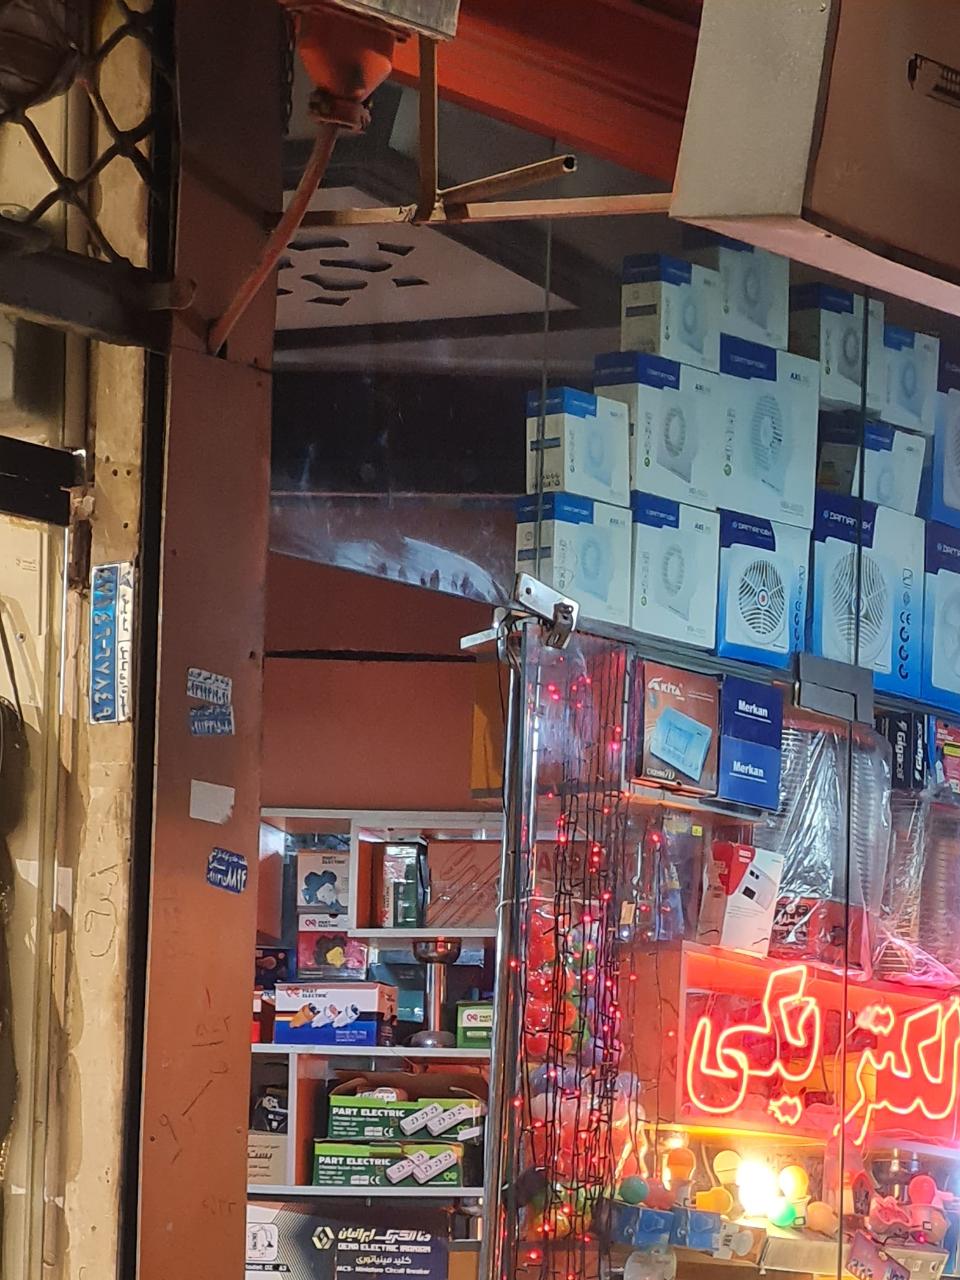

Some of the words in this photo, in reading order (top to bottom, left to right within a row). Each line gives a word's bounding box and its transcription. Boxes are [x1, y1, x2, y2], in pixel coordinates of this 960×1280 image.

[829, 511, 873, 531] DAMANEH
[738, 699, 768, 718] Merkan
[733, 760, 764, 778] Merkan
[332, 1107, 358, 1116] PART
[360, 1108, 405, 1118] ELECTRIC
[318, 1156, 345, 1165] PART
[346, 1157, 391, 1166] ELECTRIC
[360, 1243, 399, 1252] ELECTRIC
[392, 1255, 412, 1265] کلید
